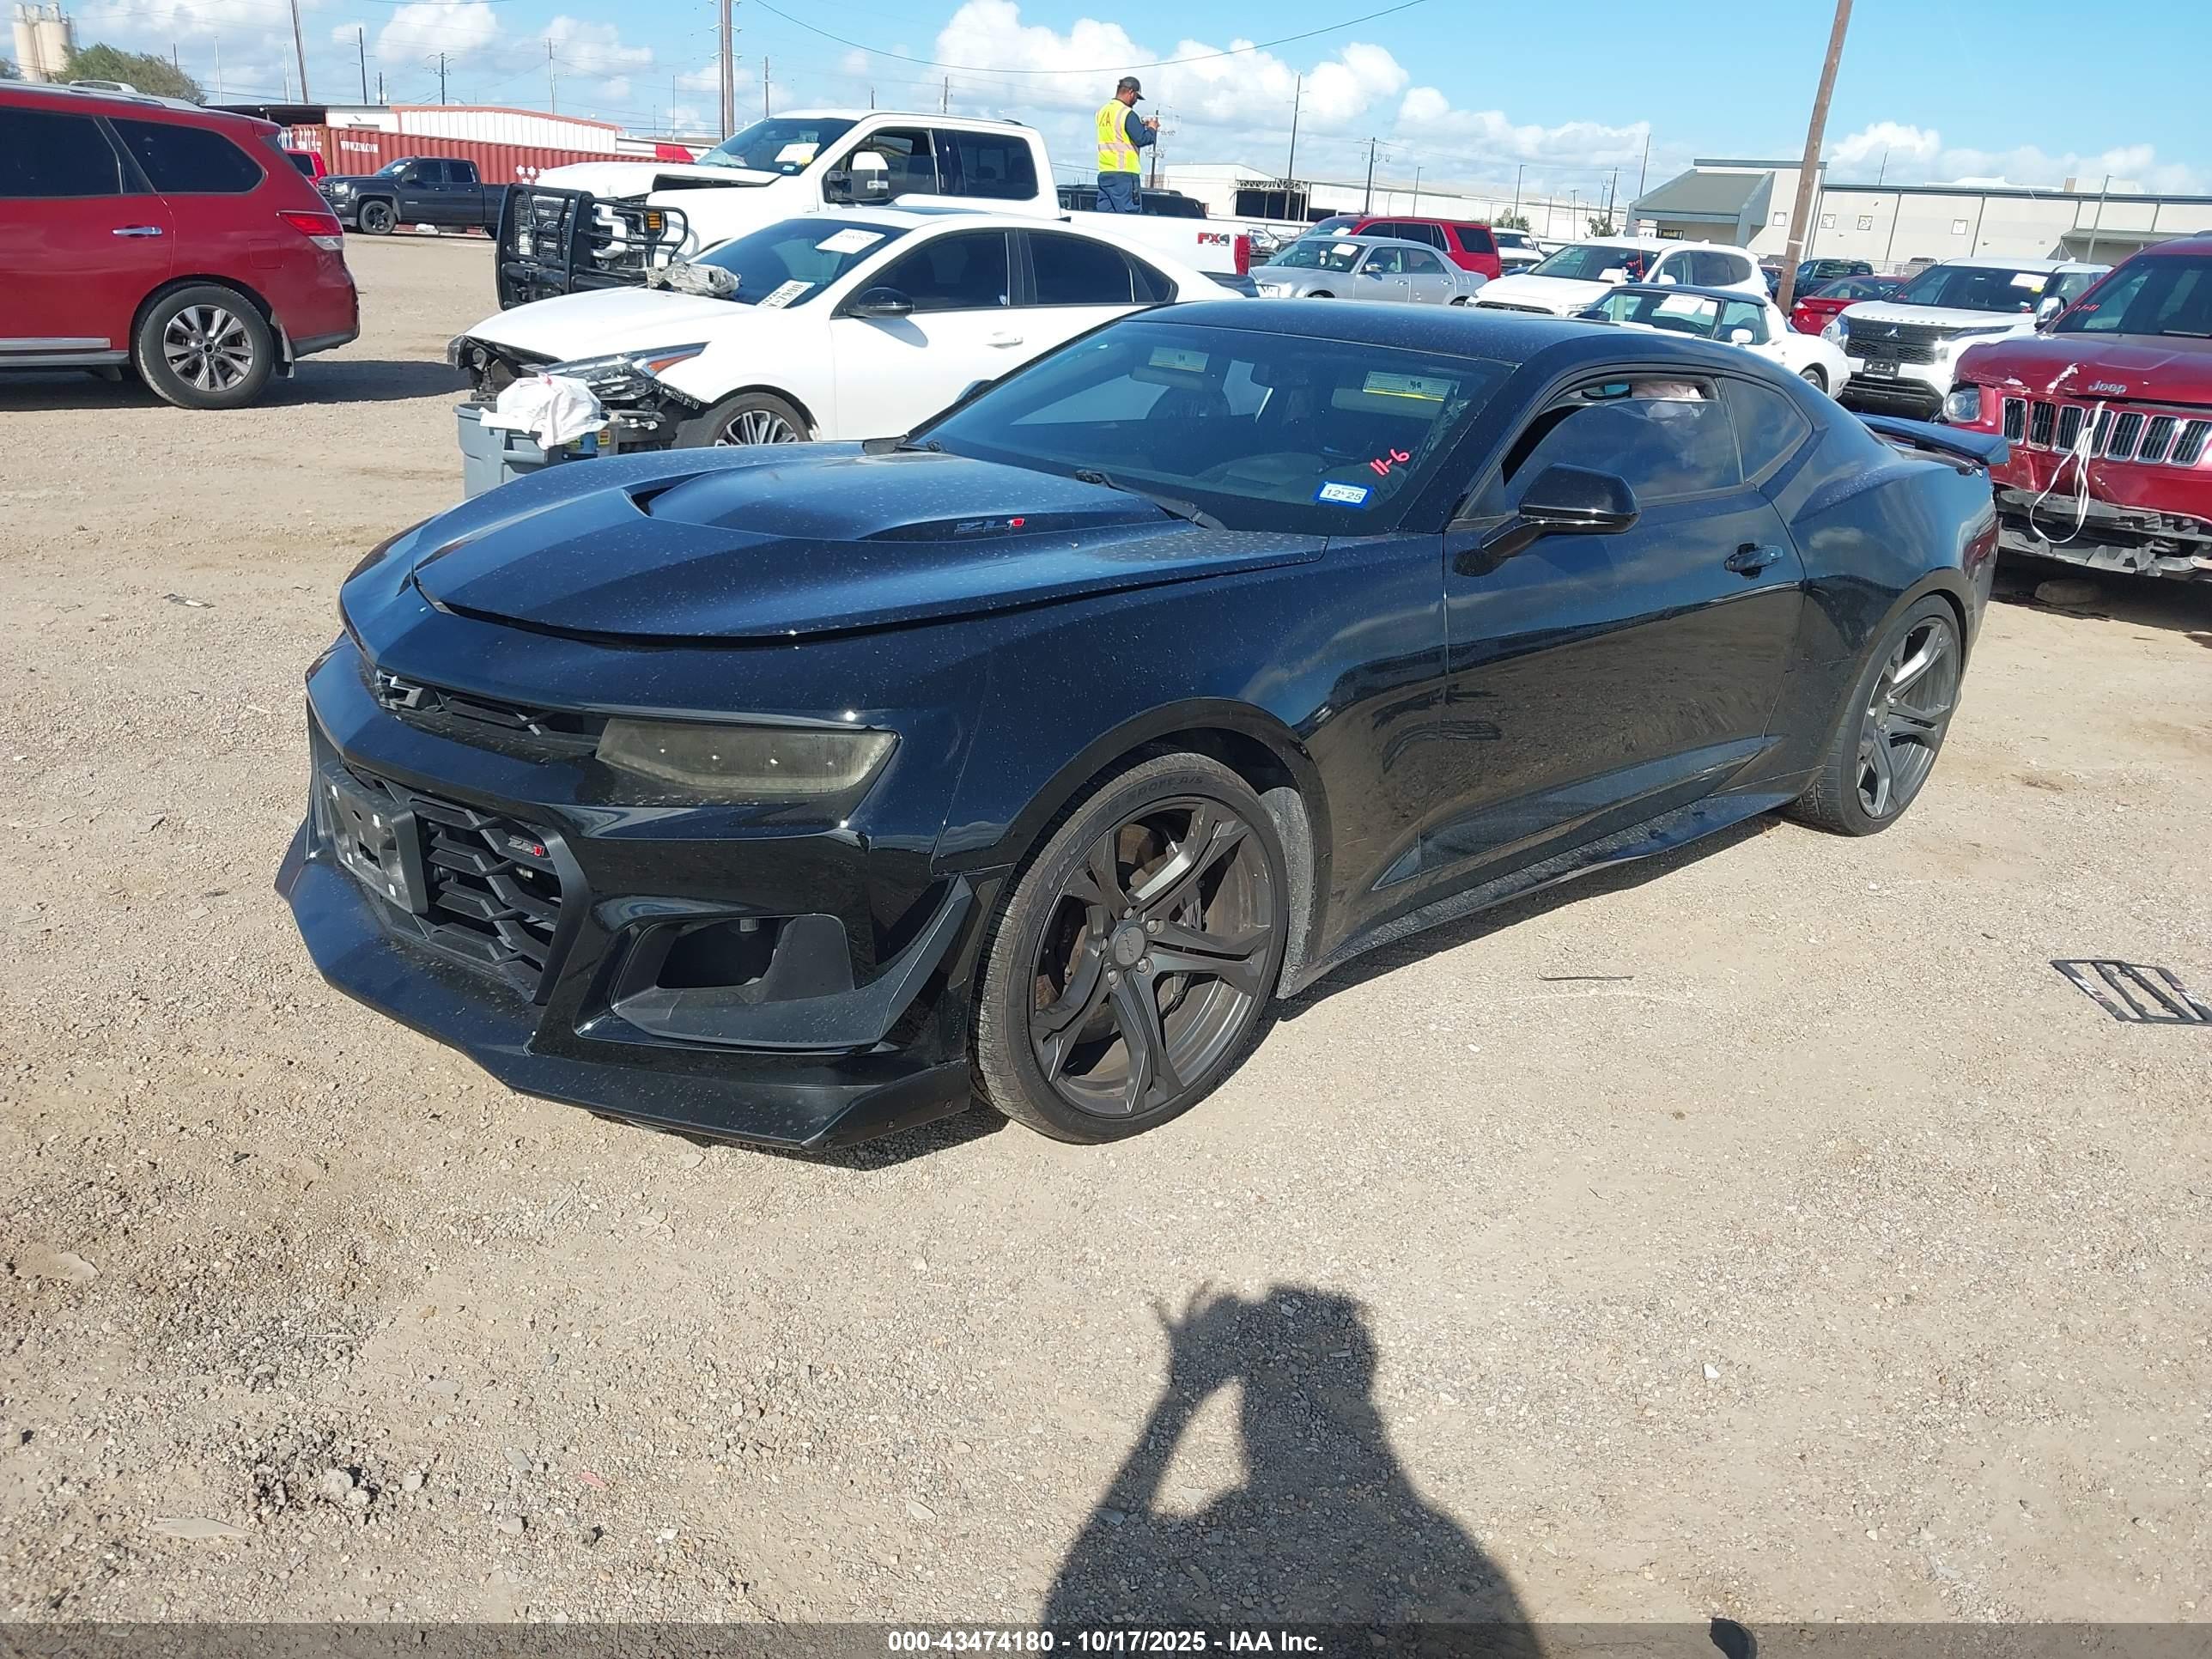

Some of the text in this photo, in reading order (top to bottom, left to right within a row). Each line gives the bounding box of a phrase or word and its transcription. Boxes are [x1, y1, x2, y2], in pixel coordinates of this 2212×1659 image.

[1197, 232, 1231, 245] FX4
[2088, 380, 2127, 395] Jeep
[1370, 448, 1410, 476] 11-6
